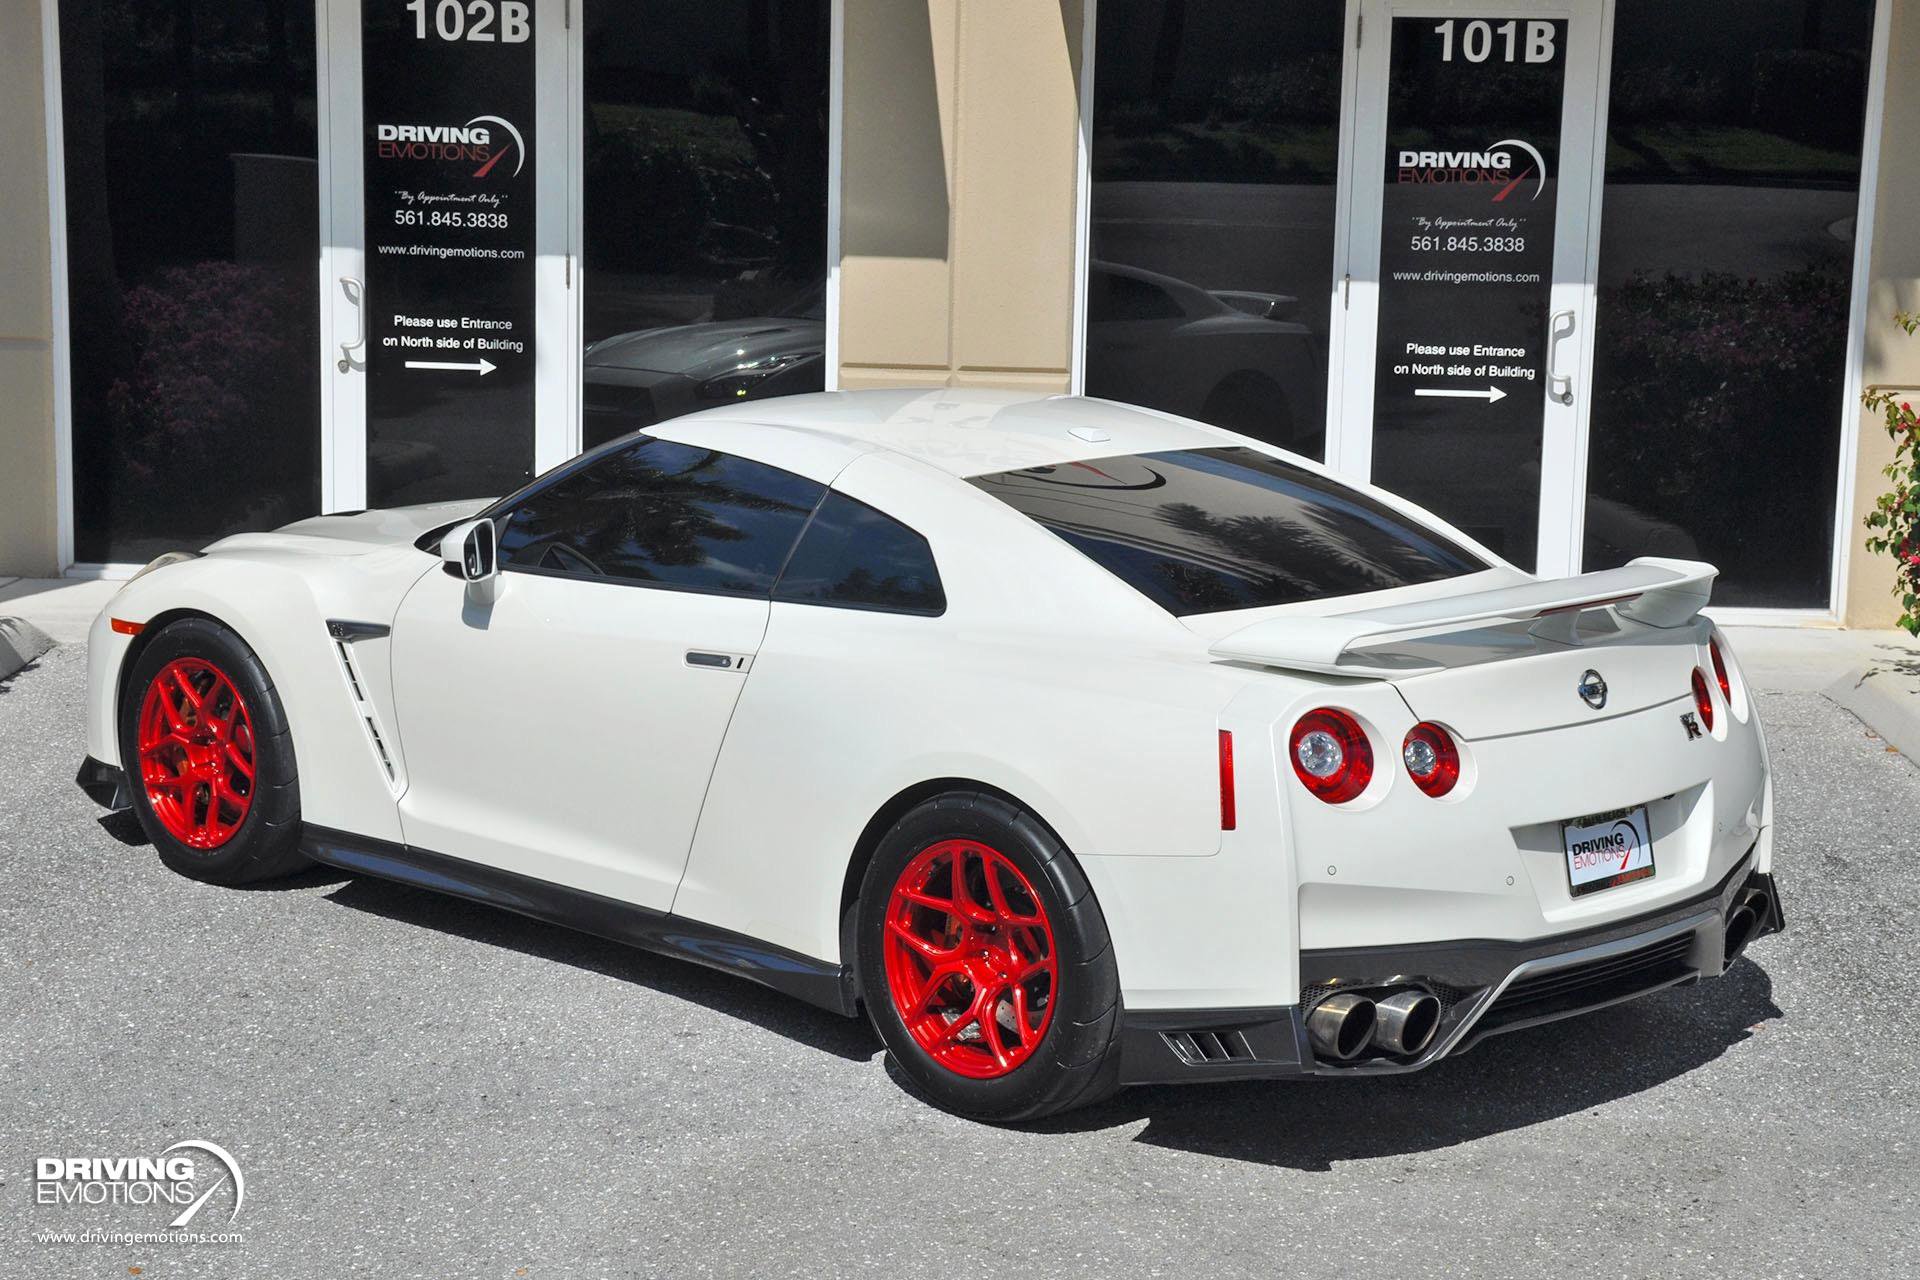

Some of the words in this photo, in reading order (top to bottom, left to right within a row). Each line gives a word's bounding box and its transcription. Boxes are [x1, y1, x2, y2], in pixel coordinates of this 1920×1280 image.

[406, 0, 530, 43] 102B
[1434, 20, 1556, 63] 101B
[378, 124, 490, 145] DRIVING
[378, 142, 491, 162] EMOTIONS
[1399, 151, 1511, 169] DRIVING
[1398, 168, 1511, 186] EMOTIONS
[417, 191, 477, 205] Appointment
[395, 209, 508, 229] 561.845.3838
[1434, 216, 1494, 230] Appointment
[378, 244, 525, 259] www.drivingemotions.com
[1411, 236, 1525, 252] 561.845.3838
[1393, 270, 1540, 284] www.drivingemotions.com
[394, 315, 434, 328] Please
[436, 318, 458, 328] use
[461, 317, 513, 330] Entrance
[383, 337, 398, 346] on
[401, 336, 433, 348] North
[436, 336, 460, 349] side
[463, 338, 475, 349] of
[478, 338, 524, 353] Building
[1406, 343, 1446, 355] Please
[1449, 346, 1470, 356] use
[1473, 345, 1526, 357] Entrance
[1394, 365, 1409, 374] on
[1412, 364, 1444, 375] North
[1447, 364, 1471, 376] side
[1474, 365, 1486, 377] of
[1489, 366, 1536, 380] Building
[1572, 832, 1625, 856] DRIVING
[1574, 844, 1626, 870] EMOTIONS
